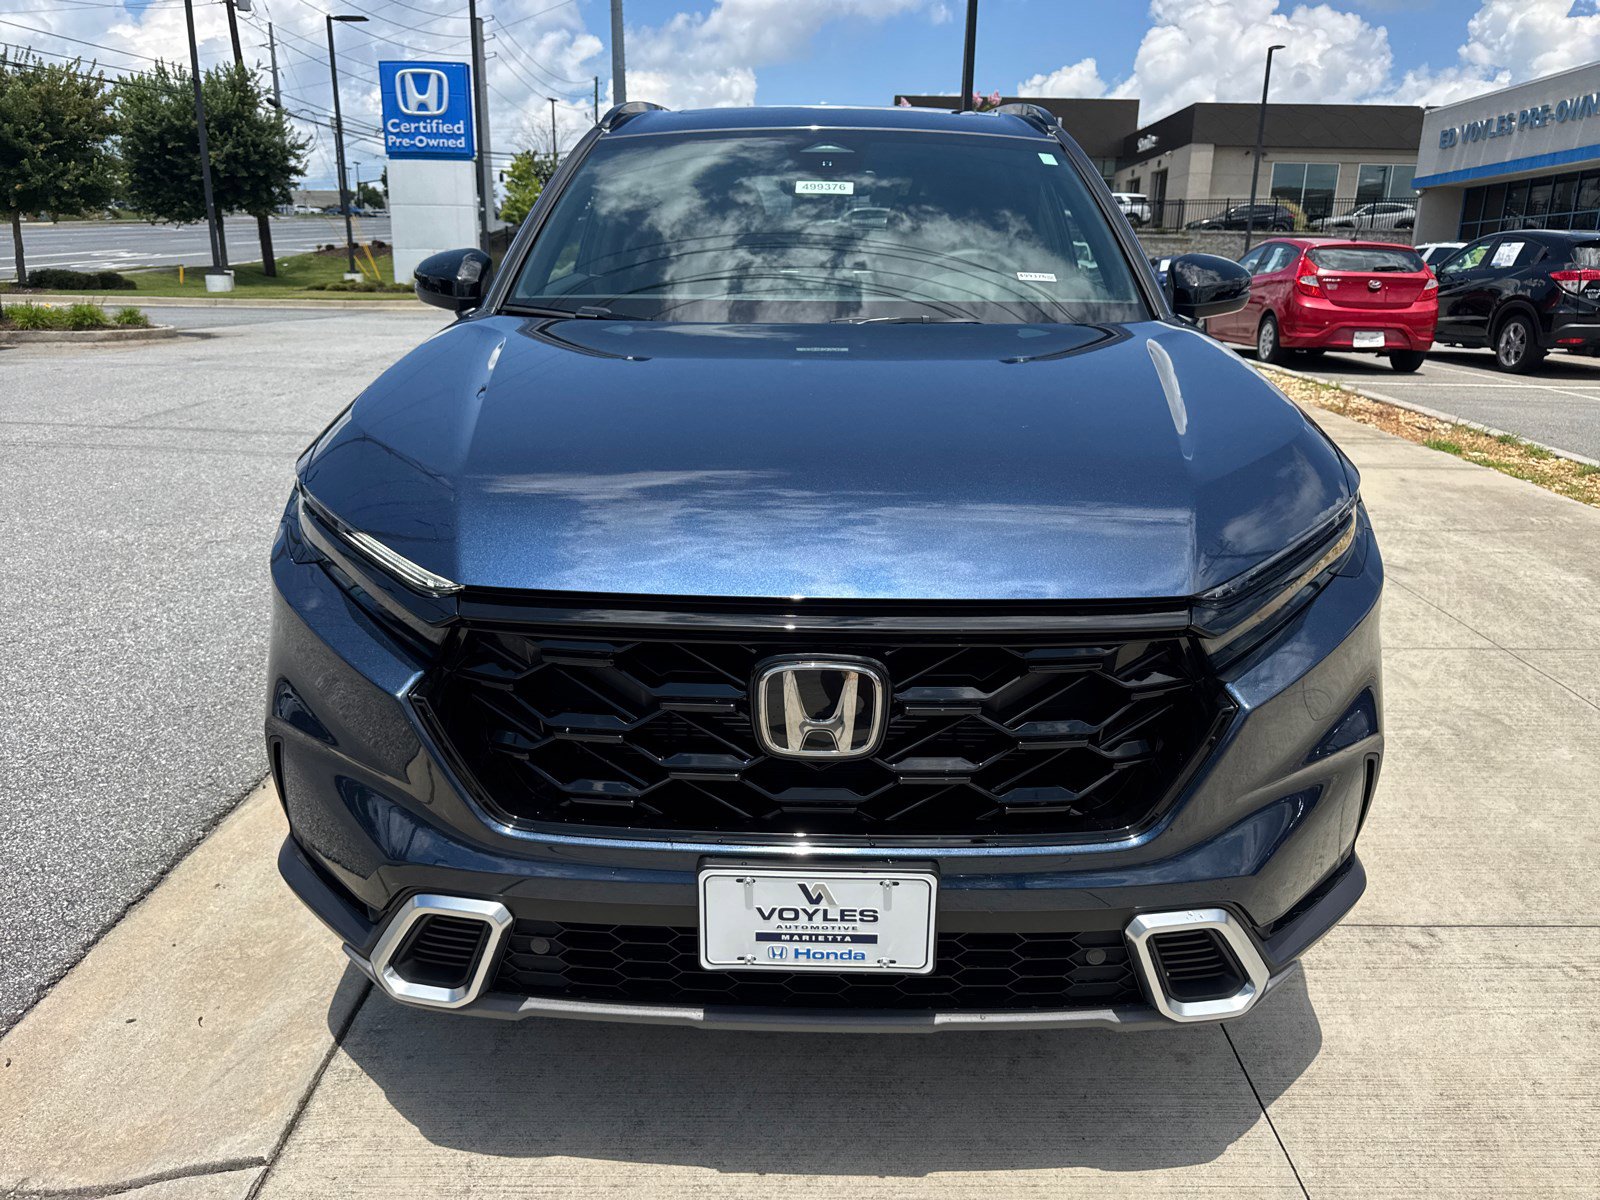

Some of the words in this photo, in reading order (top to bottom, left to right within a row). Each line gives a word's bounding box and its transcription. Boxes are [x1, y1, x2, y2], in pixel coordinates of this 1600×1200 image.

[387, 119, 464, 134] Certified
[1439, 127, 1459, 149] ED
[1461, 112, 1516, 144] VOYLES
[387, 135, 465, 148] Pre-Owned
[802, 183, 846, 191] 499376
[755, 907, 879, 923] VOYLES
[781, 934, 852, 942] MARIETTA
[794, 948, 866, 961] Honda
